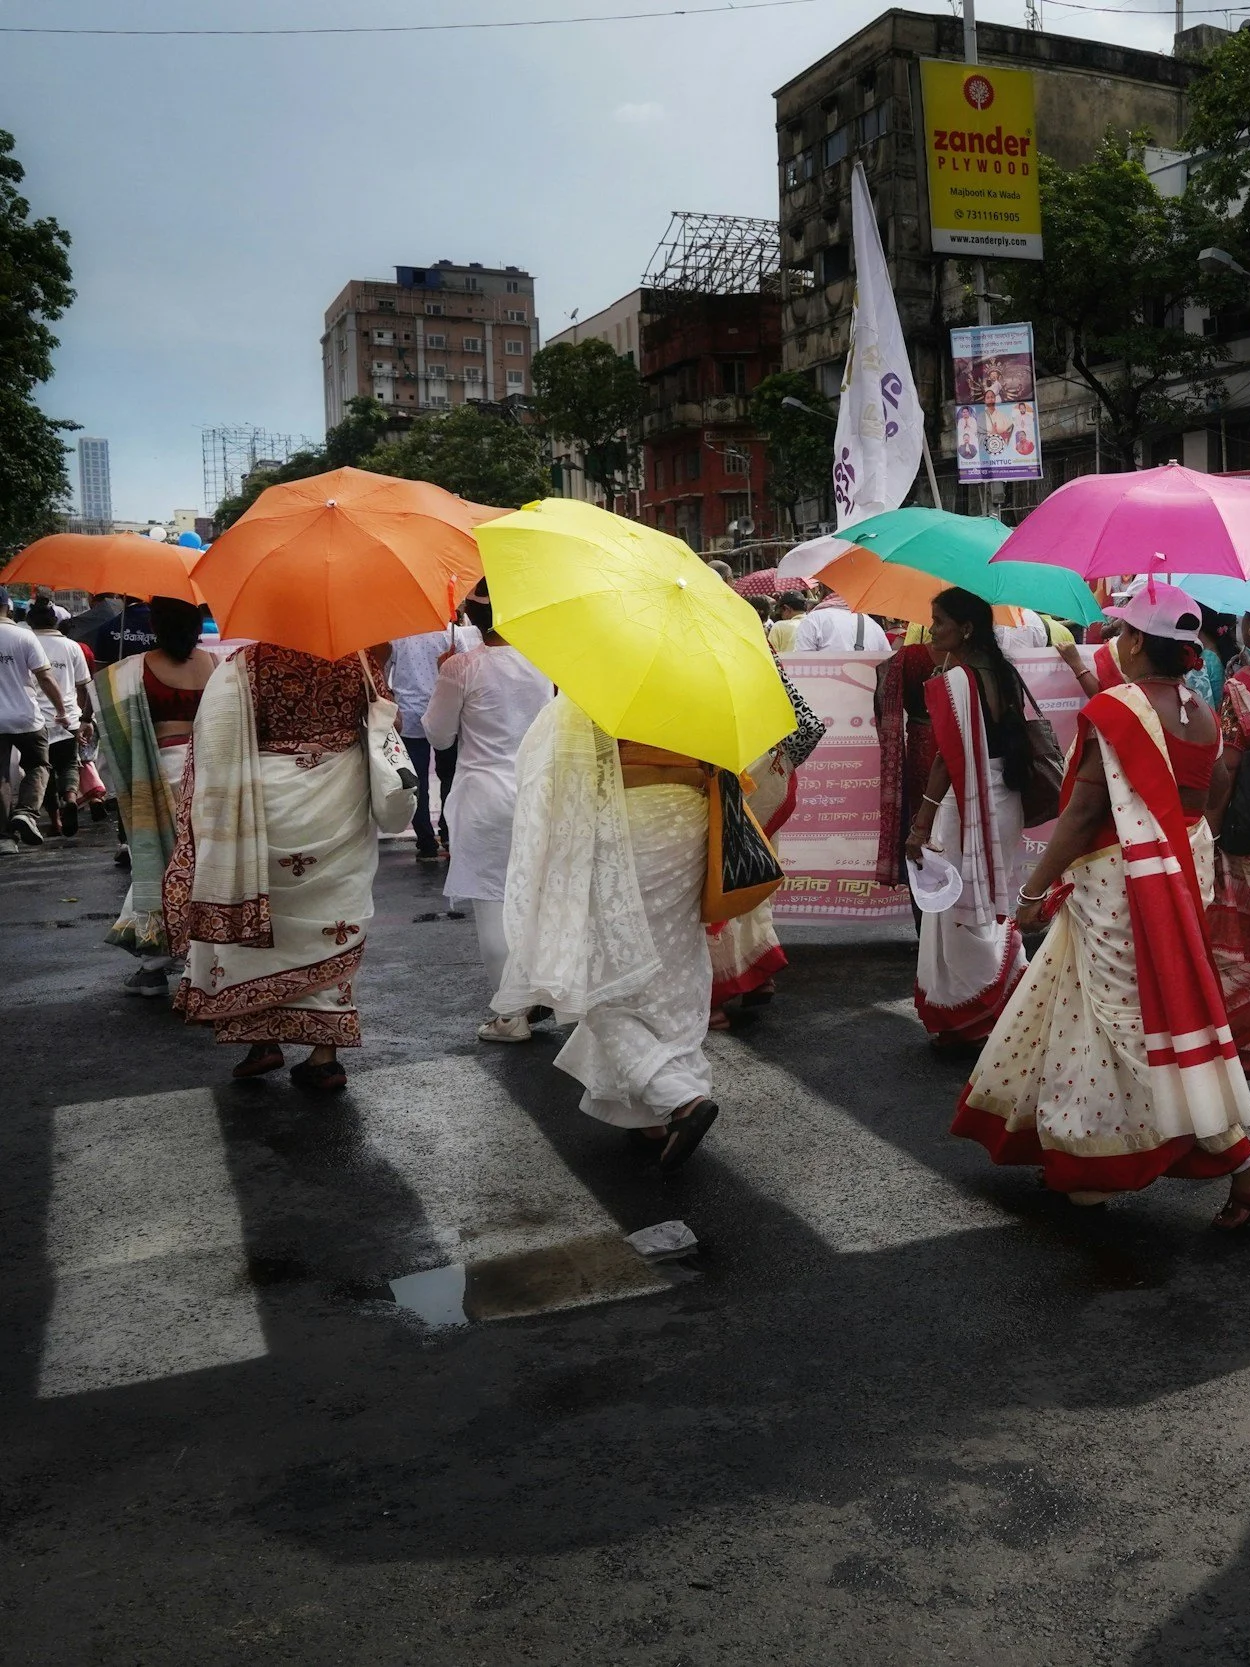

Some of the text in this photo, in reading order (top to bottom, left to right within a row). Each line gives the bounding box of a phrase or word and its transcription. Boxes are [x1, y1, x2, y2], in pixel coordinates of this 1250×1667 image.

[934, 126, 1030, 157] zander
[938, 156, 1029, 176] PLYWOOD
[950, 187, 1021, 200] Majbooti Ka Wada
[966, 210, 1020, 222] 7311161905
[950, 235, 1027, 246] www.zanderply.com
